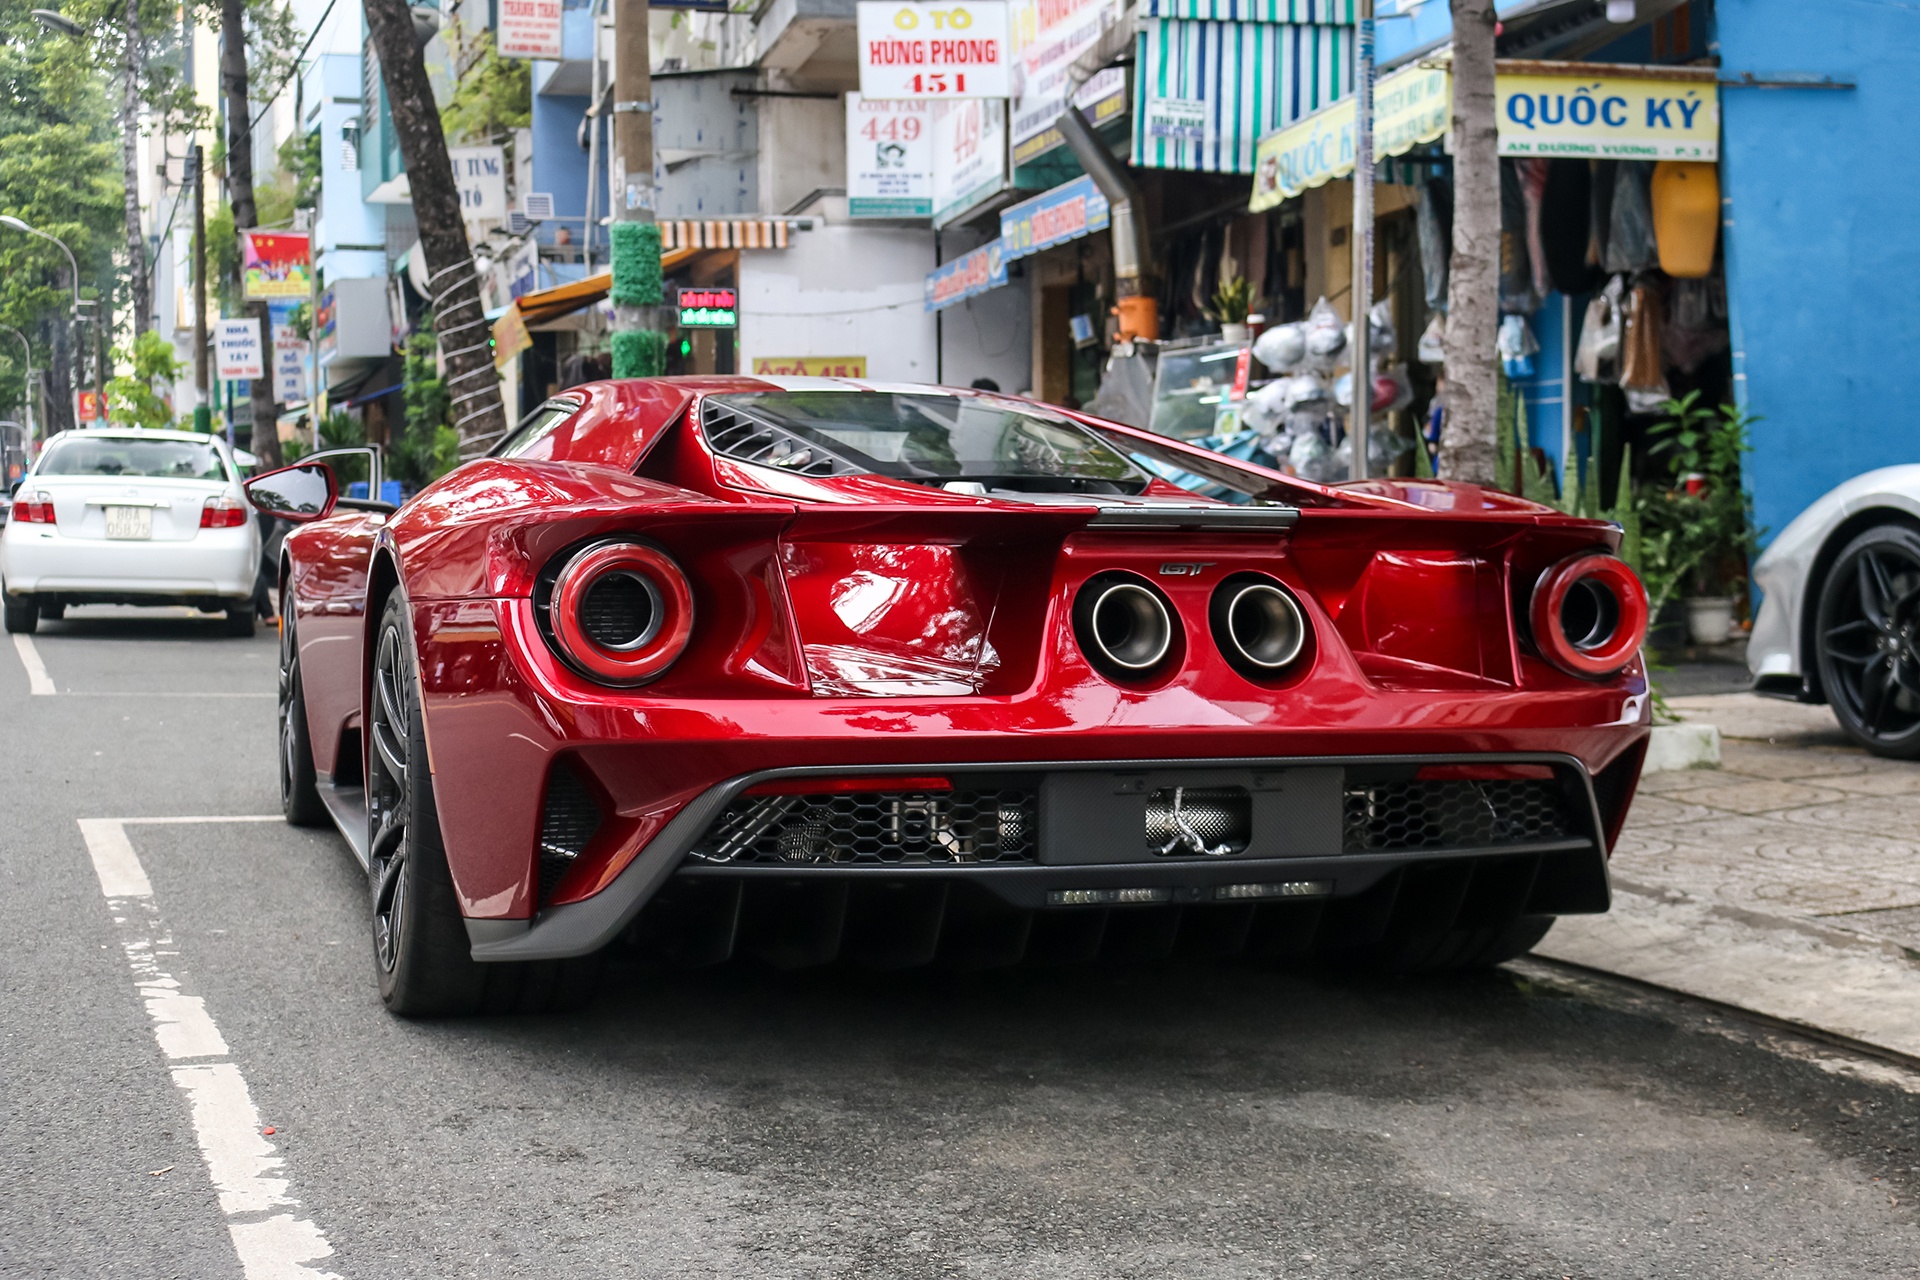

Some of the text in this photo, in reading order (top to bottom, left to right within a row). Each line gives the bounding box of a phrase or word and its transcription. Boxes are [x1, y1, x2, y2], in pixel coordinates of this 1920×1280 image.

[893, 7, 973, 30] Ô TÔ
[869, 34, 924, 65] HÙNG
[930, 40, 997, 64] PHONG
[903, 72, 966, 93] 451
[1506, 82, 1628, 130] QUỐC
[860, 115, 923, 142] 449
[1339, 119, 1356, 164] K
[1507, 142, 1531, 152] AN
[1537, 141, 1597, 154] DƯƠNG
[1602, 143, 1658, 156] VƯƠNG
[1159, 562, 1217, 577] GT
